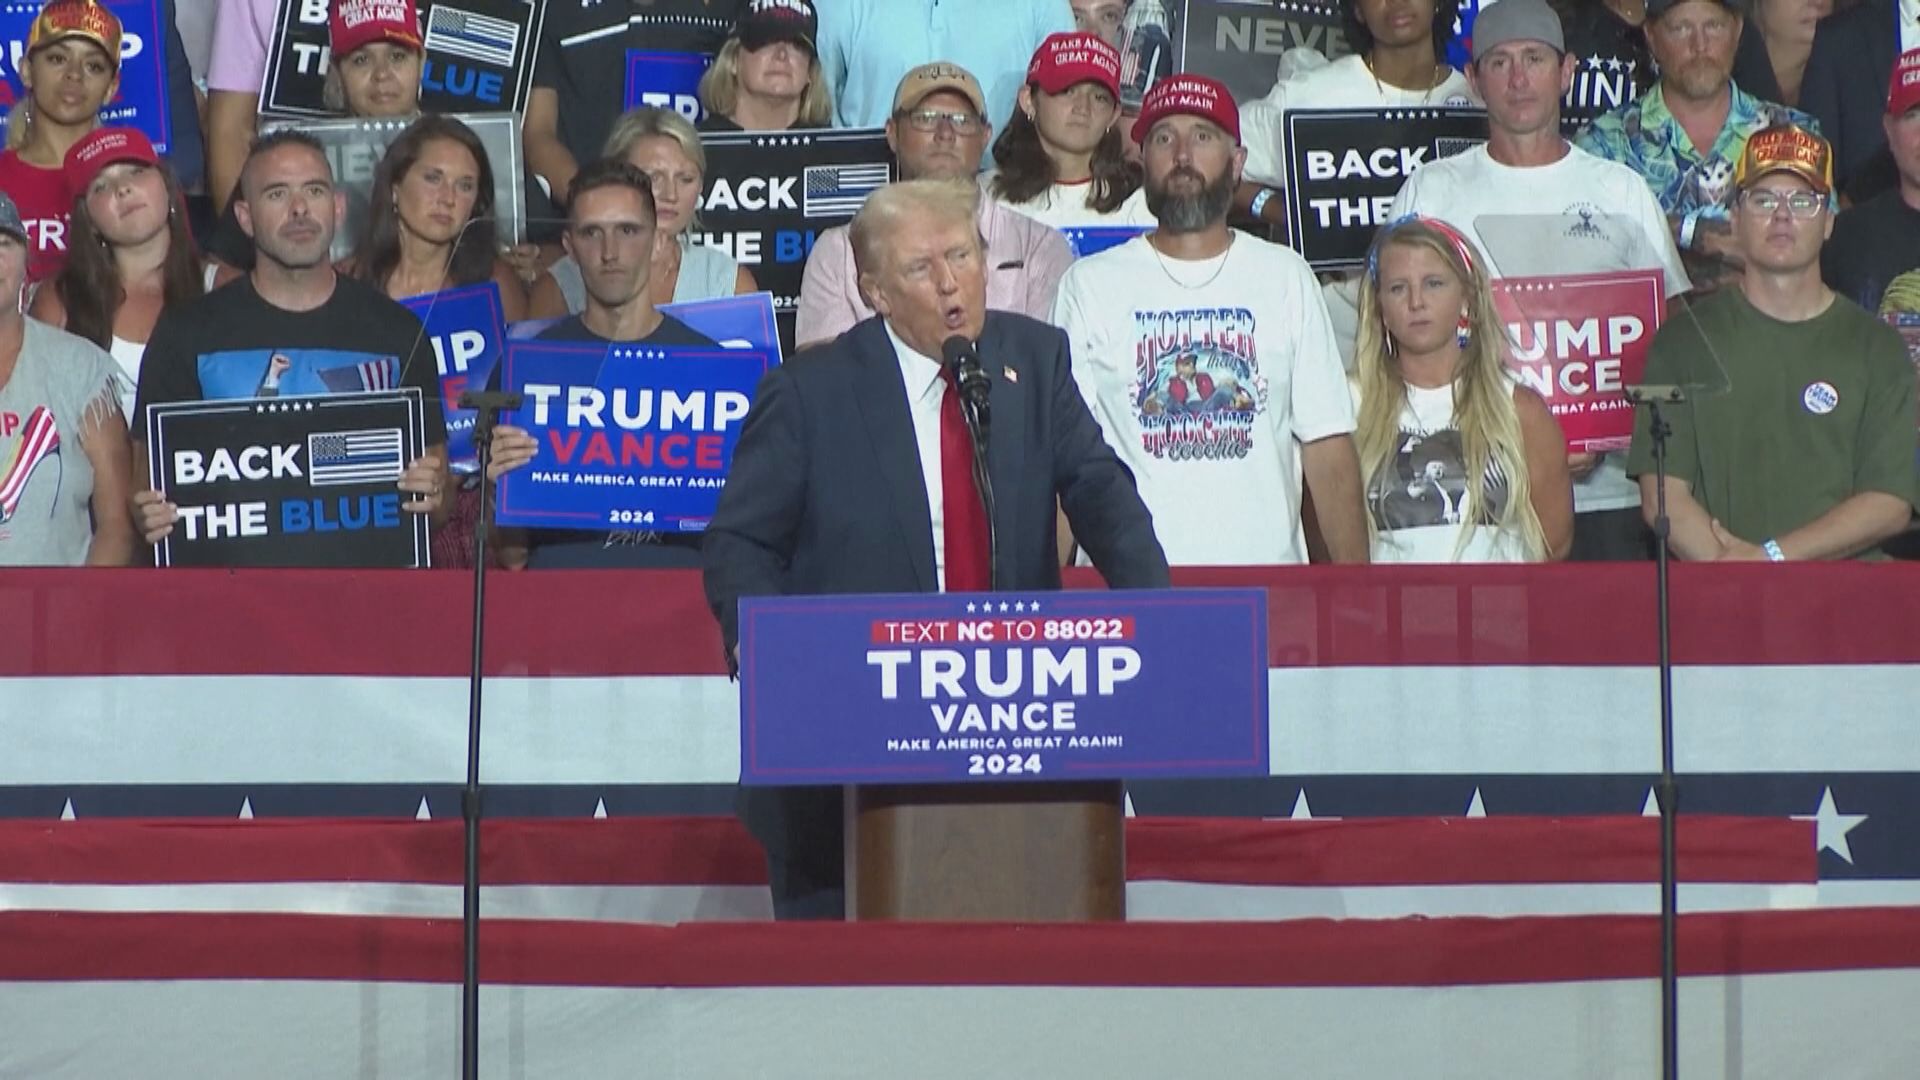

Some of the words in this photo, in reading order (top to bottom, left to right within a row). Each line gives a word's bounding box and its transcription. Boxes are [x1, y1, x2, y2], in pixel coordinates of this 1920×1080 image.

[345, 7, 376, 29] GREAT
[376, 5, 406, 23] AGAIN
[1051, 37, 1081, 52] MAKE
[1215, 15, 1350, 61] NEVE
[1055, 51, 1089, 66] GREAT
[421, 58, 505, 104] LUE
[1170, 79, 1219, 99] AMERICA
[100, 107, 137, 120] GAIN!
[1179, 94, 1214, 110] AGAIN
[1306, 146, 1428, 180] BACK
[696, 176, 798, 211] ACK
[1309, 196, 1396, 229] THE
[773, 295, 801, 308] 024
[1134, 307, 1259, 390] HOTTER
[1508, 315, 1644, 362] UMP
[1520, 358, 1623, 397] NCE
[523, 384, 750, 431] TRUMP
[174, 443, 303, 485] BACK
[548, 430, 725, 470] VANCE
[531, 471, 570, 483] MAKE
[574, 474, 635, 486] AMERICA
[640, 476, 684, 488] GREAT
[177, 502, 268, 541] THE
[281, 494, 400, 534] BLUE
[609, 510, 655, 524] 2024
[884, 621, 950, 643] TEXT
[957, 621, 995, 642] NC
[1001, 620, 1037, 641] TO
[1044, 619, 1124, 641] 88022
[866, 645, 1142, 700] TRUMP
[930, 701, 1077, 734] VANCE
[887, 739, 931, 752] MAKE
[936, 737, 1007, 751] AMERICA
[1012, 737, 1063, 750] GREAT
[1068, 735, 1124, 749] AGAIN!
[968, 752, 1043, 776] 2024
